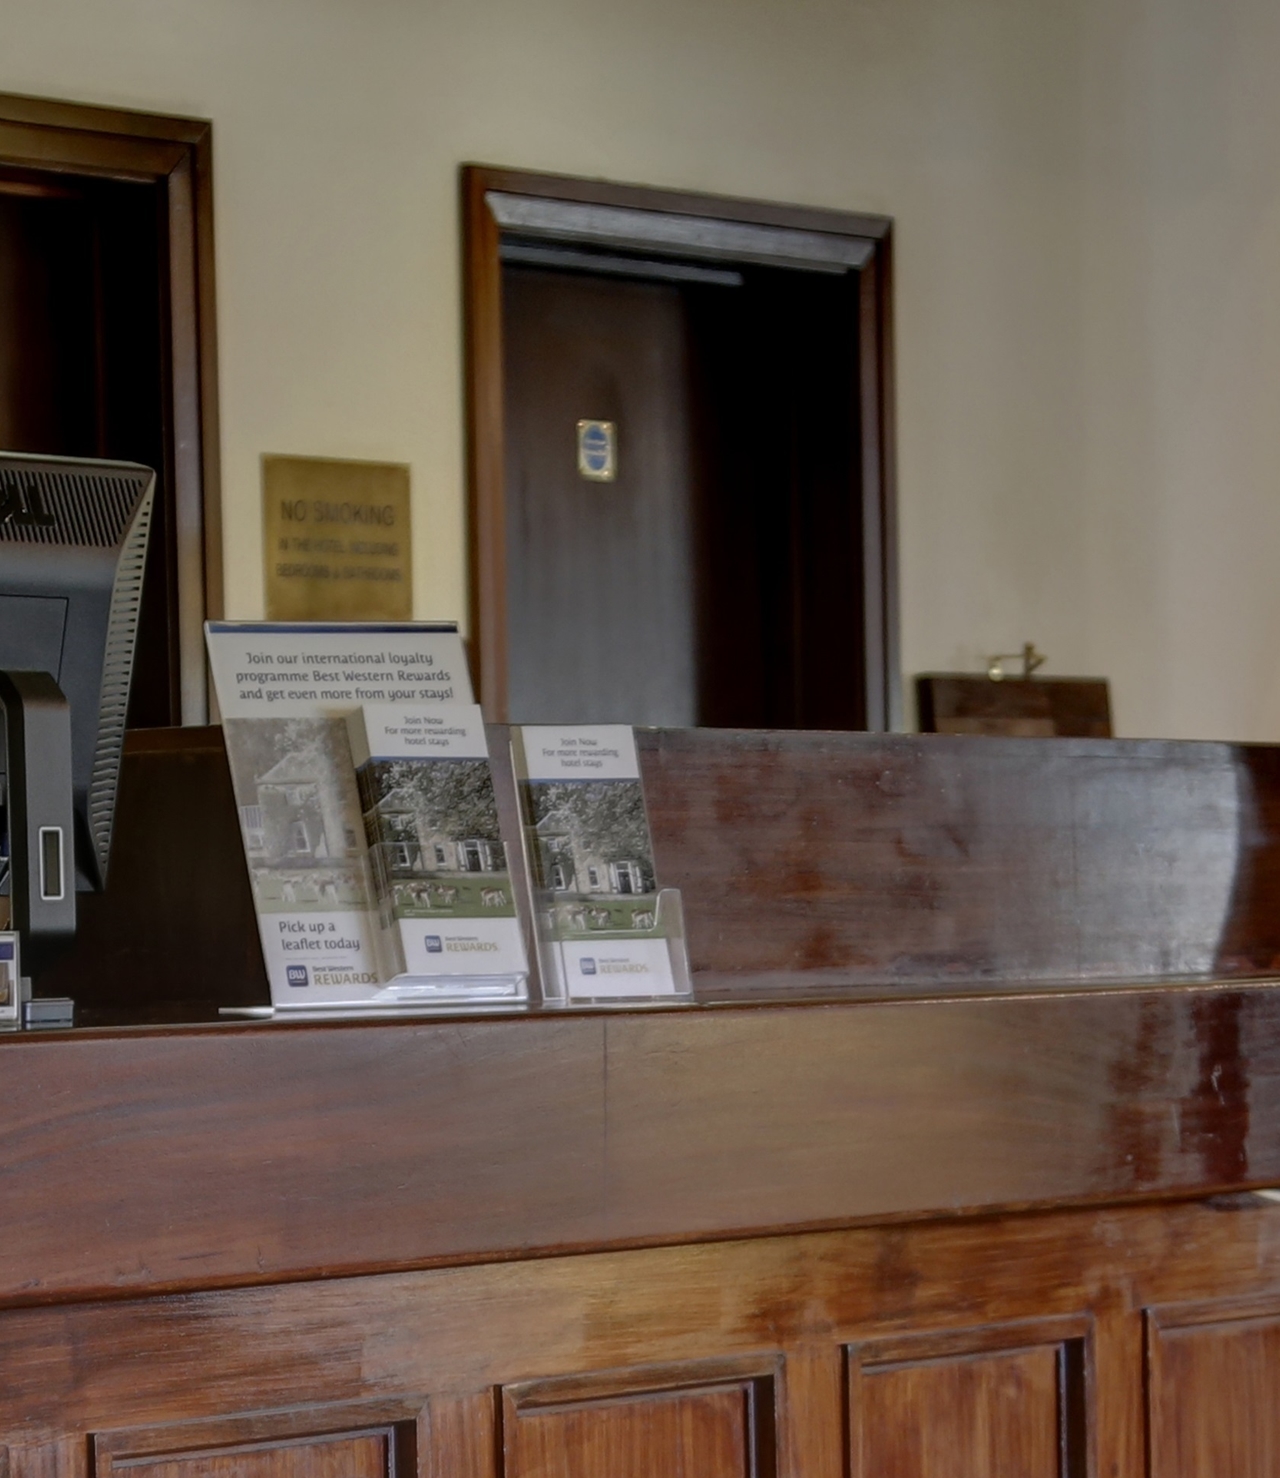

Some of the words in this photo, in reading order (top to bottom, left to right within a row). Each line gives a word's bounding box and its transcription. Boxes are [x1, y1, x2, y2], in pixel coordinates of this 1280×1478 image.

[280, 499, 307, 522] NO
[313, 500, 395, 526] SMOKING
[245, 652, 274, 664] Join
[276, 654, 298, 664] our
[302, 652, 385, 664] international
[389, 652, 433, 666] loyalty
[236, 671, 309, 684] programme
[313, 671, 340, 682] Best
[342, 670, 394, 681] Western
[398, 670, 451, 681] Rewards
[239, 688, 263, 699] and
[266, 689, 285, 702] get
[288, 690, 317, 699] even
[321, 690, 352, 699] more
[354, 687, 385, 699] from
[388, 689, 416, 701] your
[419, 687, 454, 701] stays!
[404, 716, 421, 724] Join
[423, 716, 443, 725] Now
[384, 726, 398, 735] For
[424, 727, 467, 737] rewarding
[404, 737, 426, 745] hotel
[428, 738, 449, 747] stays
[560, 738, 577, 746] Join
[578, 738, 597, 746] Now
[542, 748, 555, 756] For
[579, 748, 619, 758] rewarding
[561, 758, 581, 767] hotel
[582, 759, 603, 768] stays
[278, 920, 306, 933] Pick
[309, 922, 325, 934] up
[328, 922, 336, 932] a
[281, 938, 322, 951] leaflet
[324, 937, 360, 951] today
[446, 942, 498, 952] REWARDS
[599, 963, 648, 974] REWARDS
[288, 969, 306, 980] BW
[314, 972, 379, 985] REWARDS
